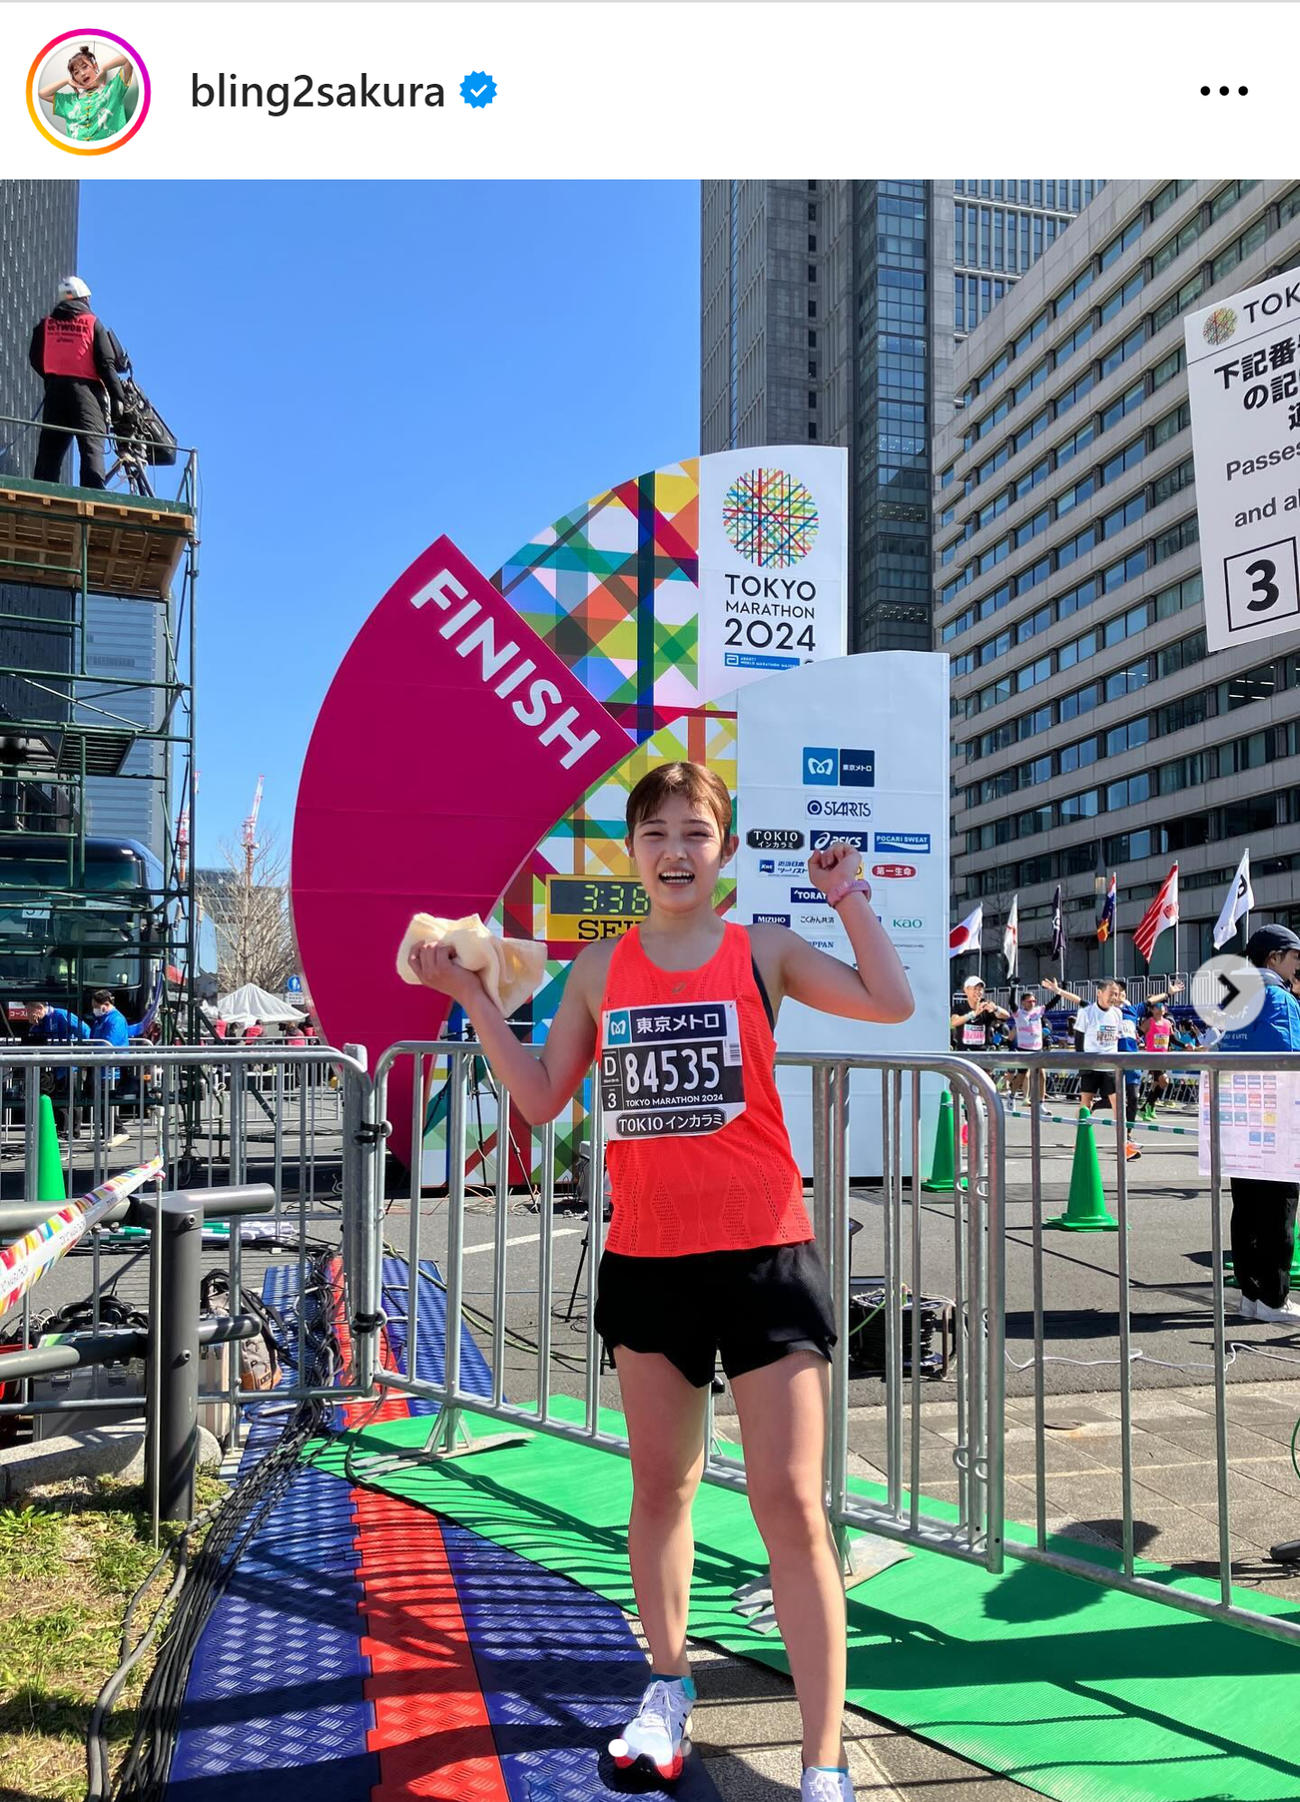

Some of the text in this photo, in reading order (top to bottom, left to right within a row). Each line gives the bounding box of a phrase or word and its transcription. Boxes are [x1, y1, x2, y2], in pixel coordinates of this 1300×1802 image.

[1214, 334, 1300, 390] 下記番
[1243, 370, 1300, 410] の記
[1234, 497, 1277, 527] and
[724, 574, 816, 601] TOKYO
[1245, 559, 1280, 612] 3
[726, 600, 815, 619] MARATHON
[724, 618, 816, 651] 2024
[410, 568, 601, 770] FINISH
[824, 801, 871, 817] STARTS
[753, 830, 799, 842] TOKIO
[876, 835, 903, 843] POCARI
[757, 916, 786, 924] MIZUHO
[635, 1012, 721, 1035] 東京メトロ
[604, 1056, 617, 1077] D
[624, 1047, 721, 1095] 84535
[607, 1092, 617, 1109] 3
[625, 1093, 724, 1108] TOKYO MARATHON 2024
[618, 1112, 723, 1133] TOKIO インカラミ
